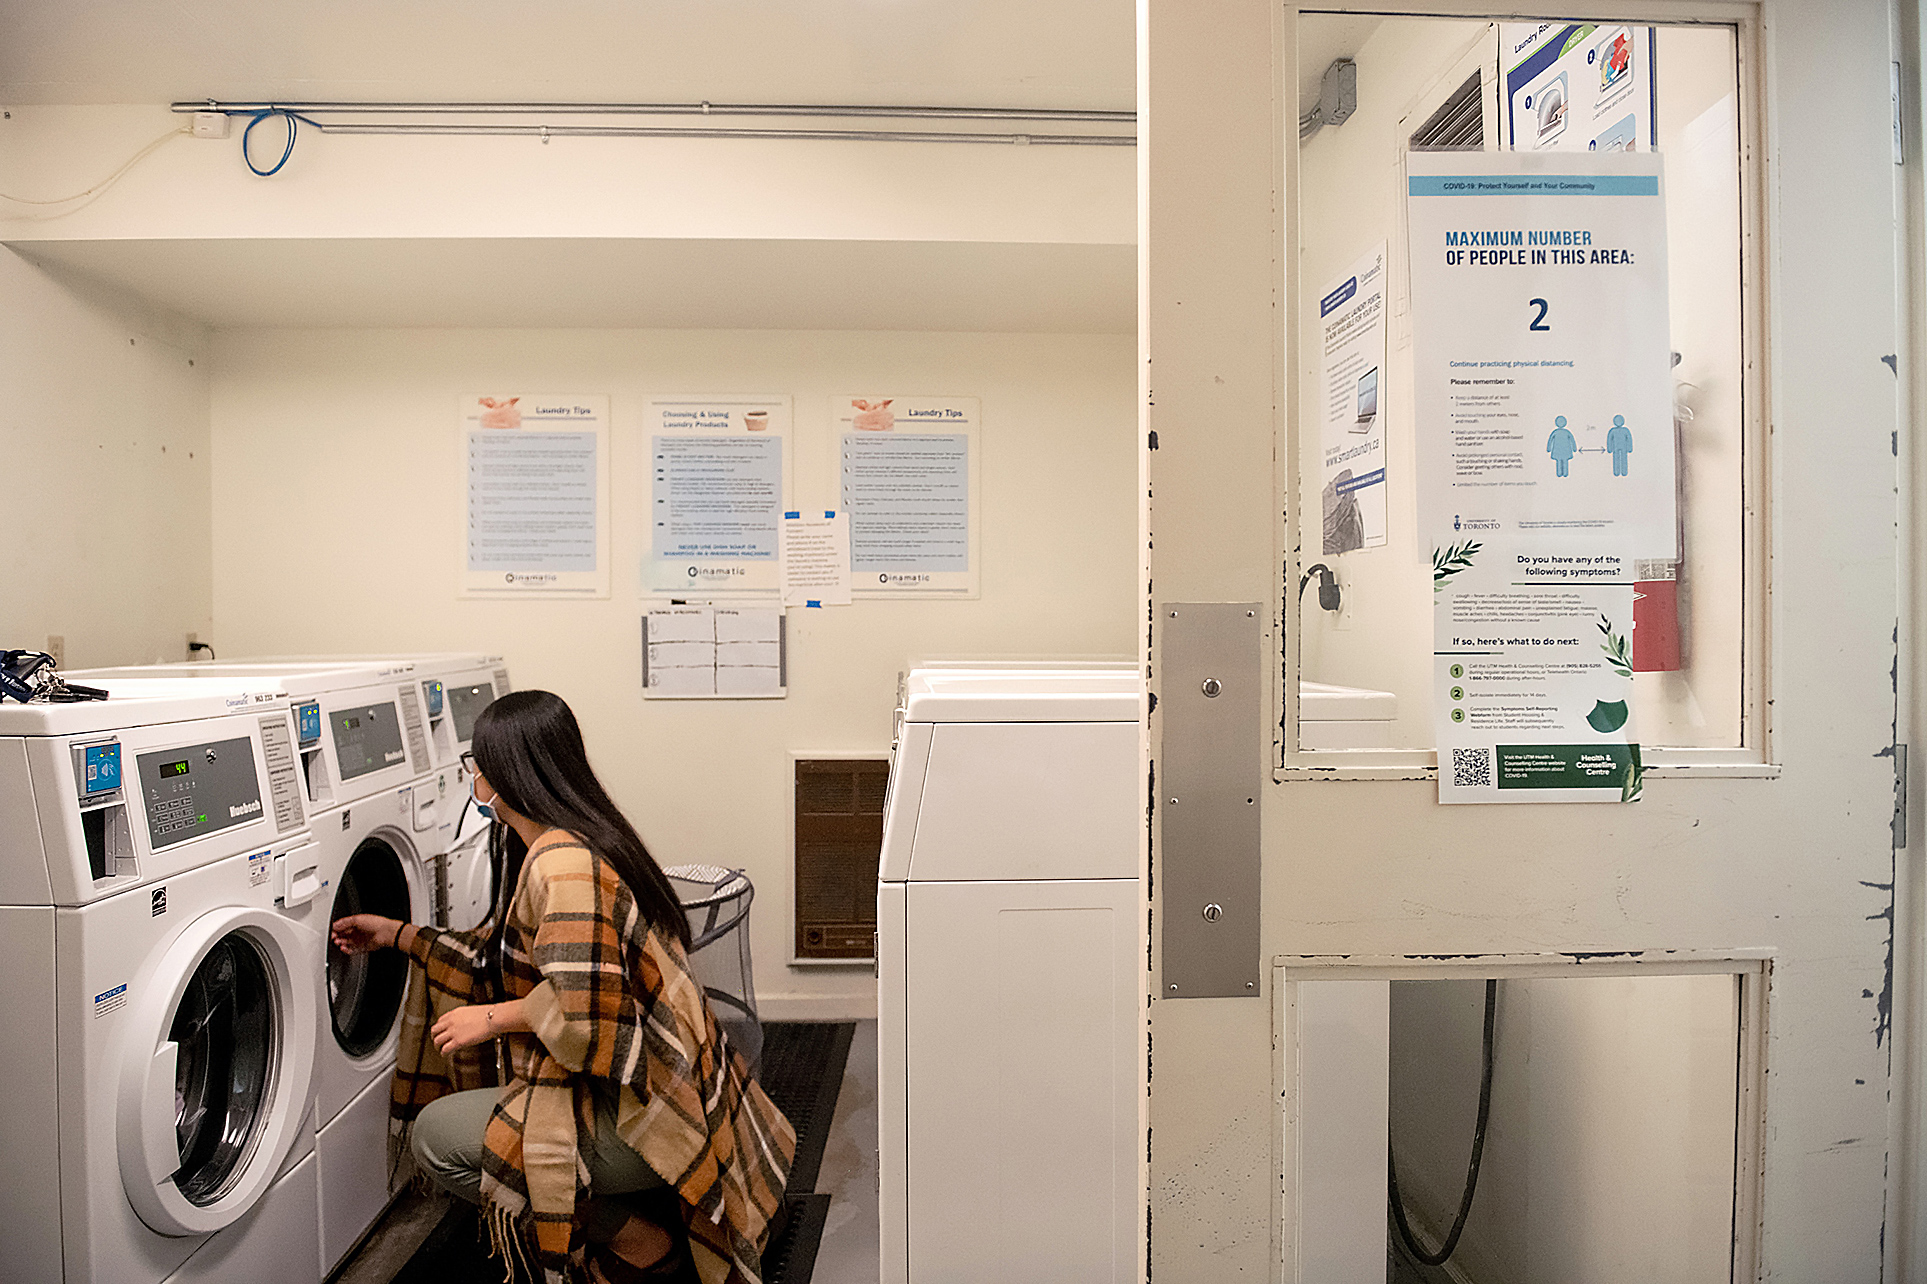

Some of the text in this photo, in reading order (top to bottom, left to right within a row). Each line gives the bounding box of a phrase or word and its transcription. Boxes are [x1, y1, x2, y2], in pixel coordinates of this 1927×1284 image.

[1514, 31, 1538, 54] Laundry
[1443, 182, 1595, 191] COVID-19: Protect Yourself and Your Community
[1446, 231, 1592, 246] MAXIMUM NUMBER
[1446, 250, 1635, 265] OF PEOPLE IN THIS AREA:
[1529, 297, 1551, 332] 2
[536, 406, 591, 415] Laundry Tips
[662, 411, 697, 419] Choosing
[708, 411, 729, 419] Using
[908, 408, 963, 417] Laundry Tips
[1525, 568, 1621, 577] following symptoms?
[175, 762, 186, 774] 44
[99, 986, 123, 1001] NOTICE
